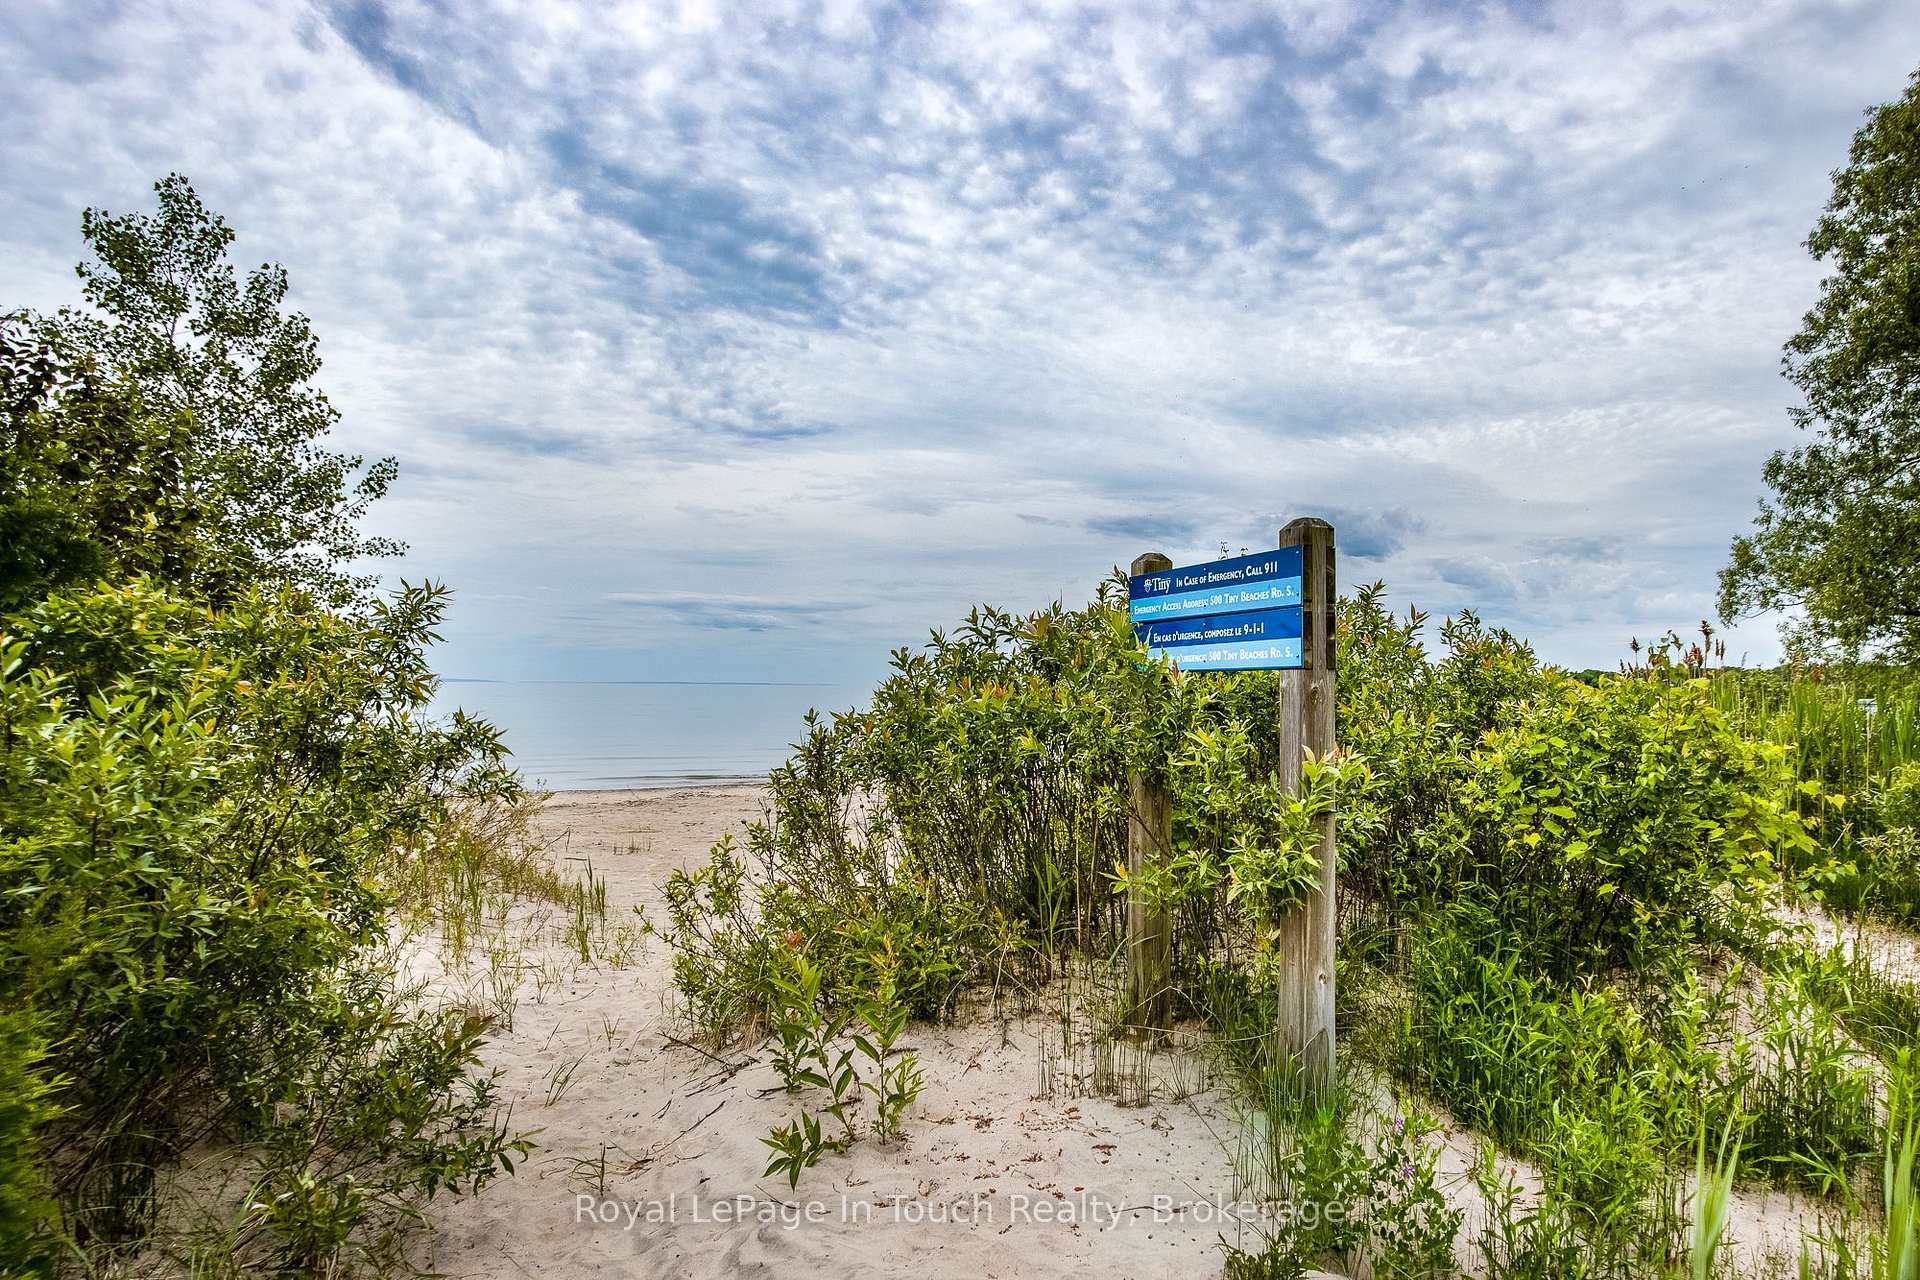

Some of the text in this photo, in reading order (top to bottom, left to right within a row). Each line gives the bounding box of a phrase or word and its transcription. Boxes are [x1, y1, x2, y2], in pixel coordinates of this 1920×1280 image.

[1184, 575, 1199, 586] CASE
[1199, 575, 1207, 584] OF
[1208, 569, 1245, 583] EMERGENCY,
[1246, 565, 1263, 577] CALL
[1264, 560, 1278, 574] 911
[1152, 577, 1171, 593] Tiny
[1162, 600, 1182, 612] ACCESS
[1210, 594, 1223, 606] 500
[1223, 592, 1239, 604] TINY
[1240, 590, 1269, 602] BEACHES
[1153, 632, 1161, 643] EN
[1162, 632, 1172, 642] CAS
[1204, 627, 1234, 639] COMPOSEZ
[1235, 627, 1242, 636] LE
[1243, 621, 1265, 635] 9-1-1
[1208, 650, 1221, 662] 500
[1222, 649, 1238, 661] TINY
[1239, 648, 1268, 660] BEACHES
